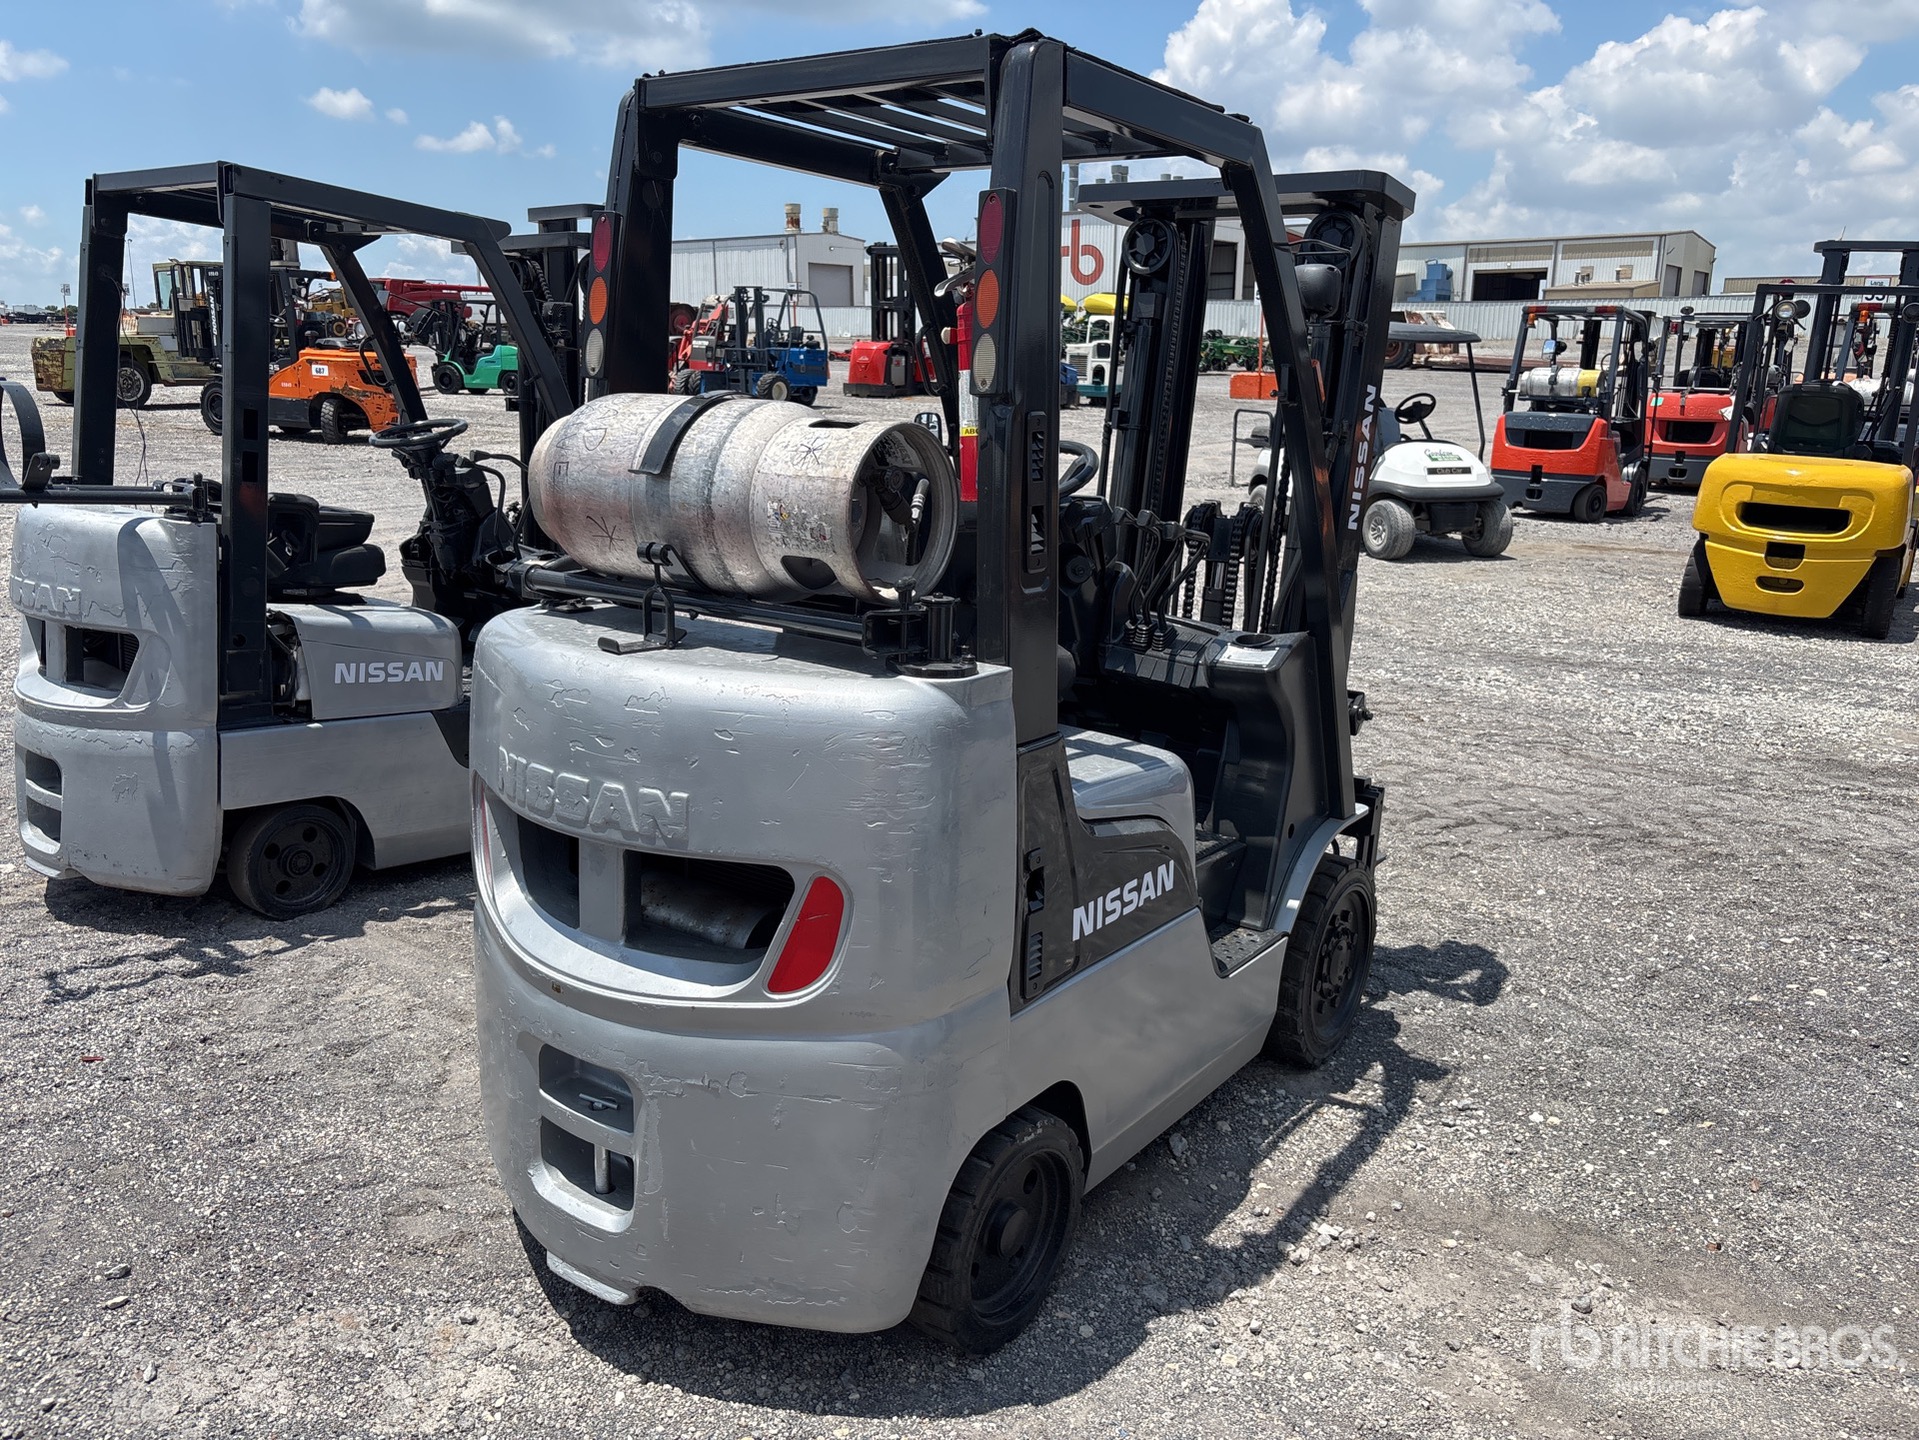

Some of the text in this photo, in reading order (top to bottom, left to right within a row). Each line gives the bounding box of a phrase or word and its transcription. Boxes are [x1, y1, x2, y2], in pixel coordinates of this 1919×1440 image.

[1347, 384, 1377, 531] NISSAN
[1512, 416, 1581, 431] TOYOTA
[334, 661, 444, 684] NISSAN
[498, 745, 690, 849] NISSAN
[1072, 859, 1175, 942] NISSAN
